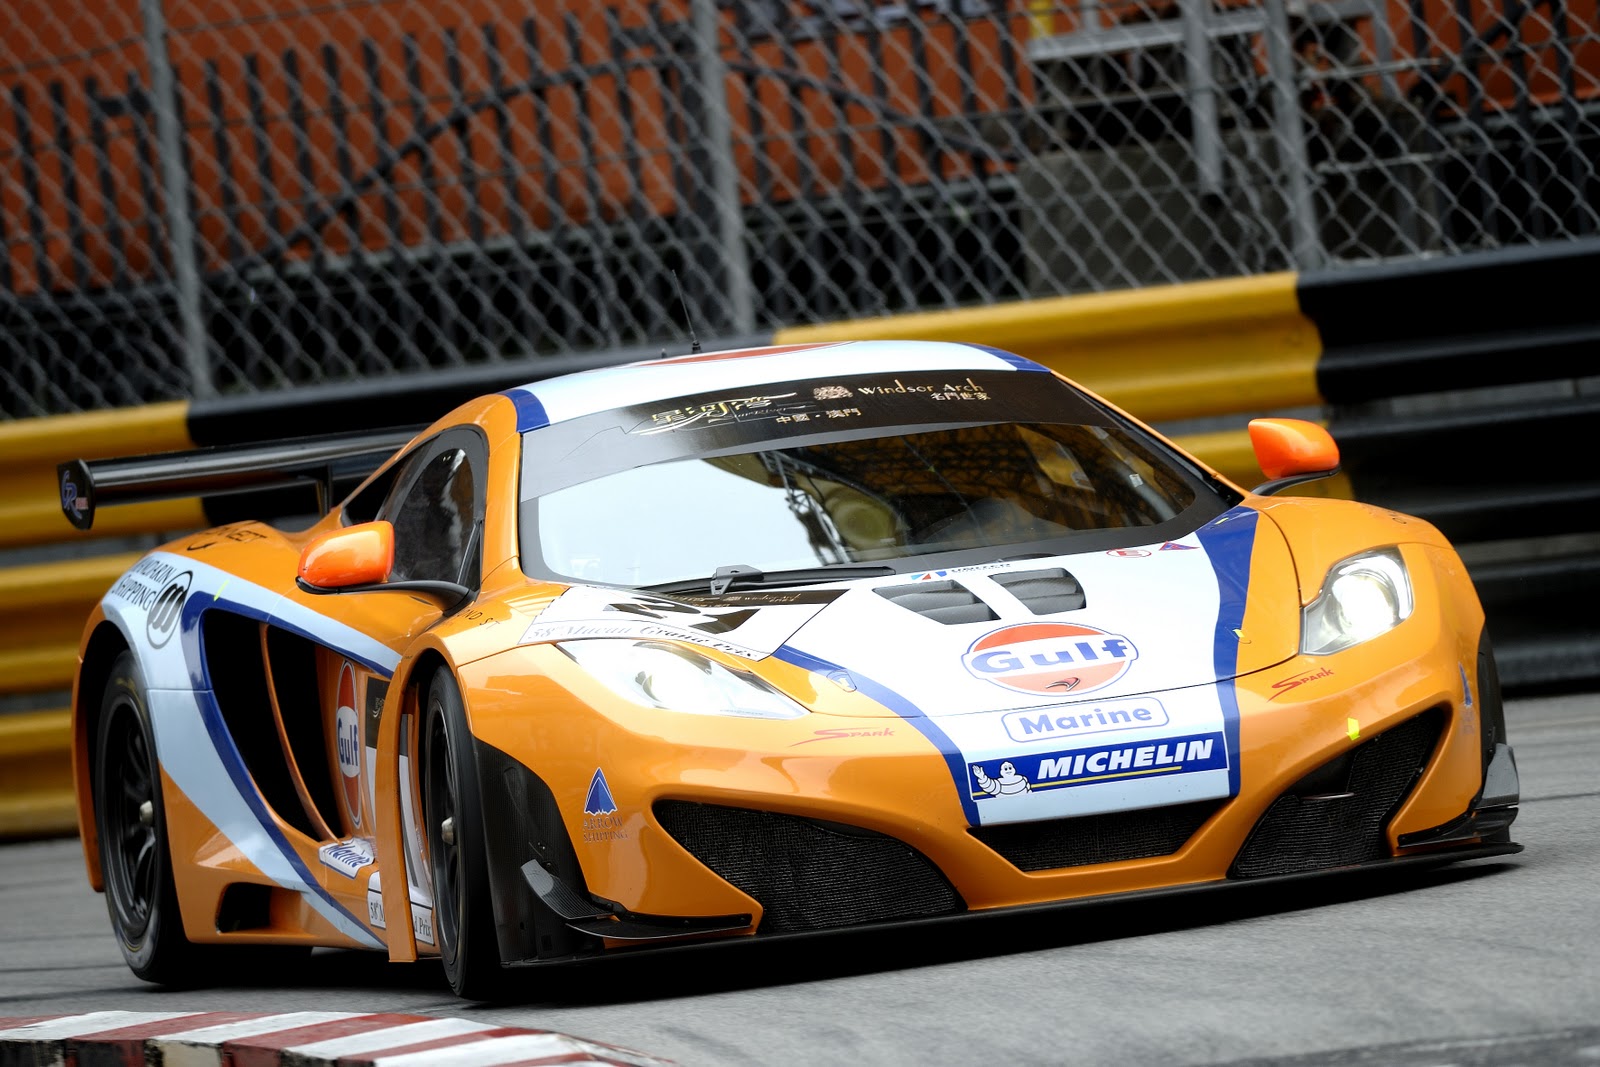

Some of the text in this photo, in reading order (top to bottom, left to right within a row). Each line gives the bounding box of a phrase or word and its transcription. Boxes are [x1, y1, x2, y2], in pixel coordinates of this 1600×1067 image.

[857, 376, 984, 397] Windsor Arch
[111, 574, 157, 612] SHIPPING
[638, 625, 711, 644] Grand
[712, 641, 761, 659] Prix
[970, 638, 1130, 674] Gulf
[1018, 704, 1154, 735] Marine
[338, 716, 360, 767] Gulf
[1036, 738, 1214, 781] MICHELIN
[583, 815, 623, 831] ARROW
[583, 829, 628, 843] SHIPPING
[327, 842, 370, 869] Marine
